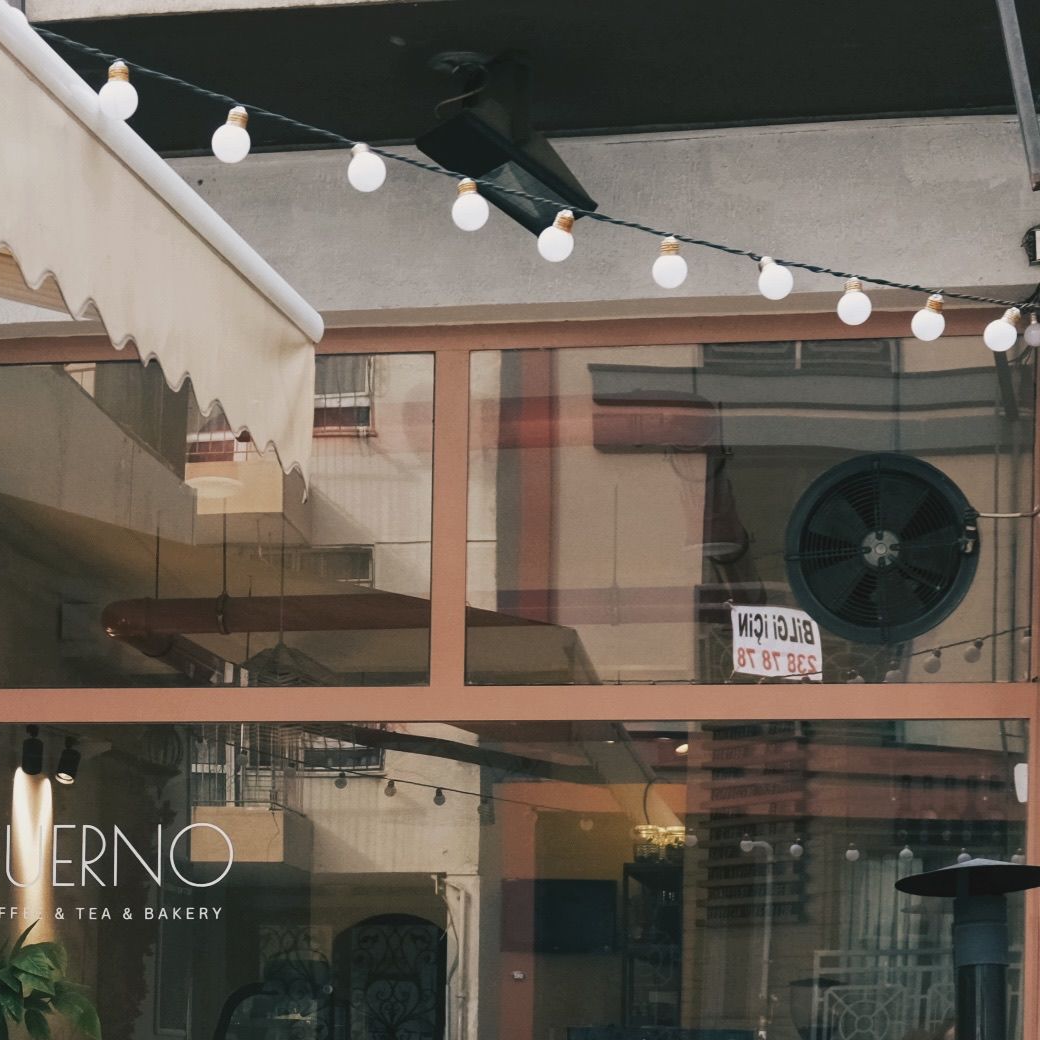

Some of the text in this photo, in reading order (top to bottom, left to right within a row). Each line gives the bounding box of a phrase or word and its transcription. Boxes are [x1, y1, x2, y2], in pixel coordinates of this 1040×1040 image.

[54, 907, 65, 920] &
[75, 907, 111, 920] TEA
[122, 907, 133, 920] &
[144, 907, 223, 920] BAKERY
